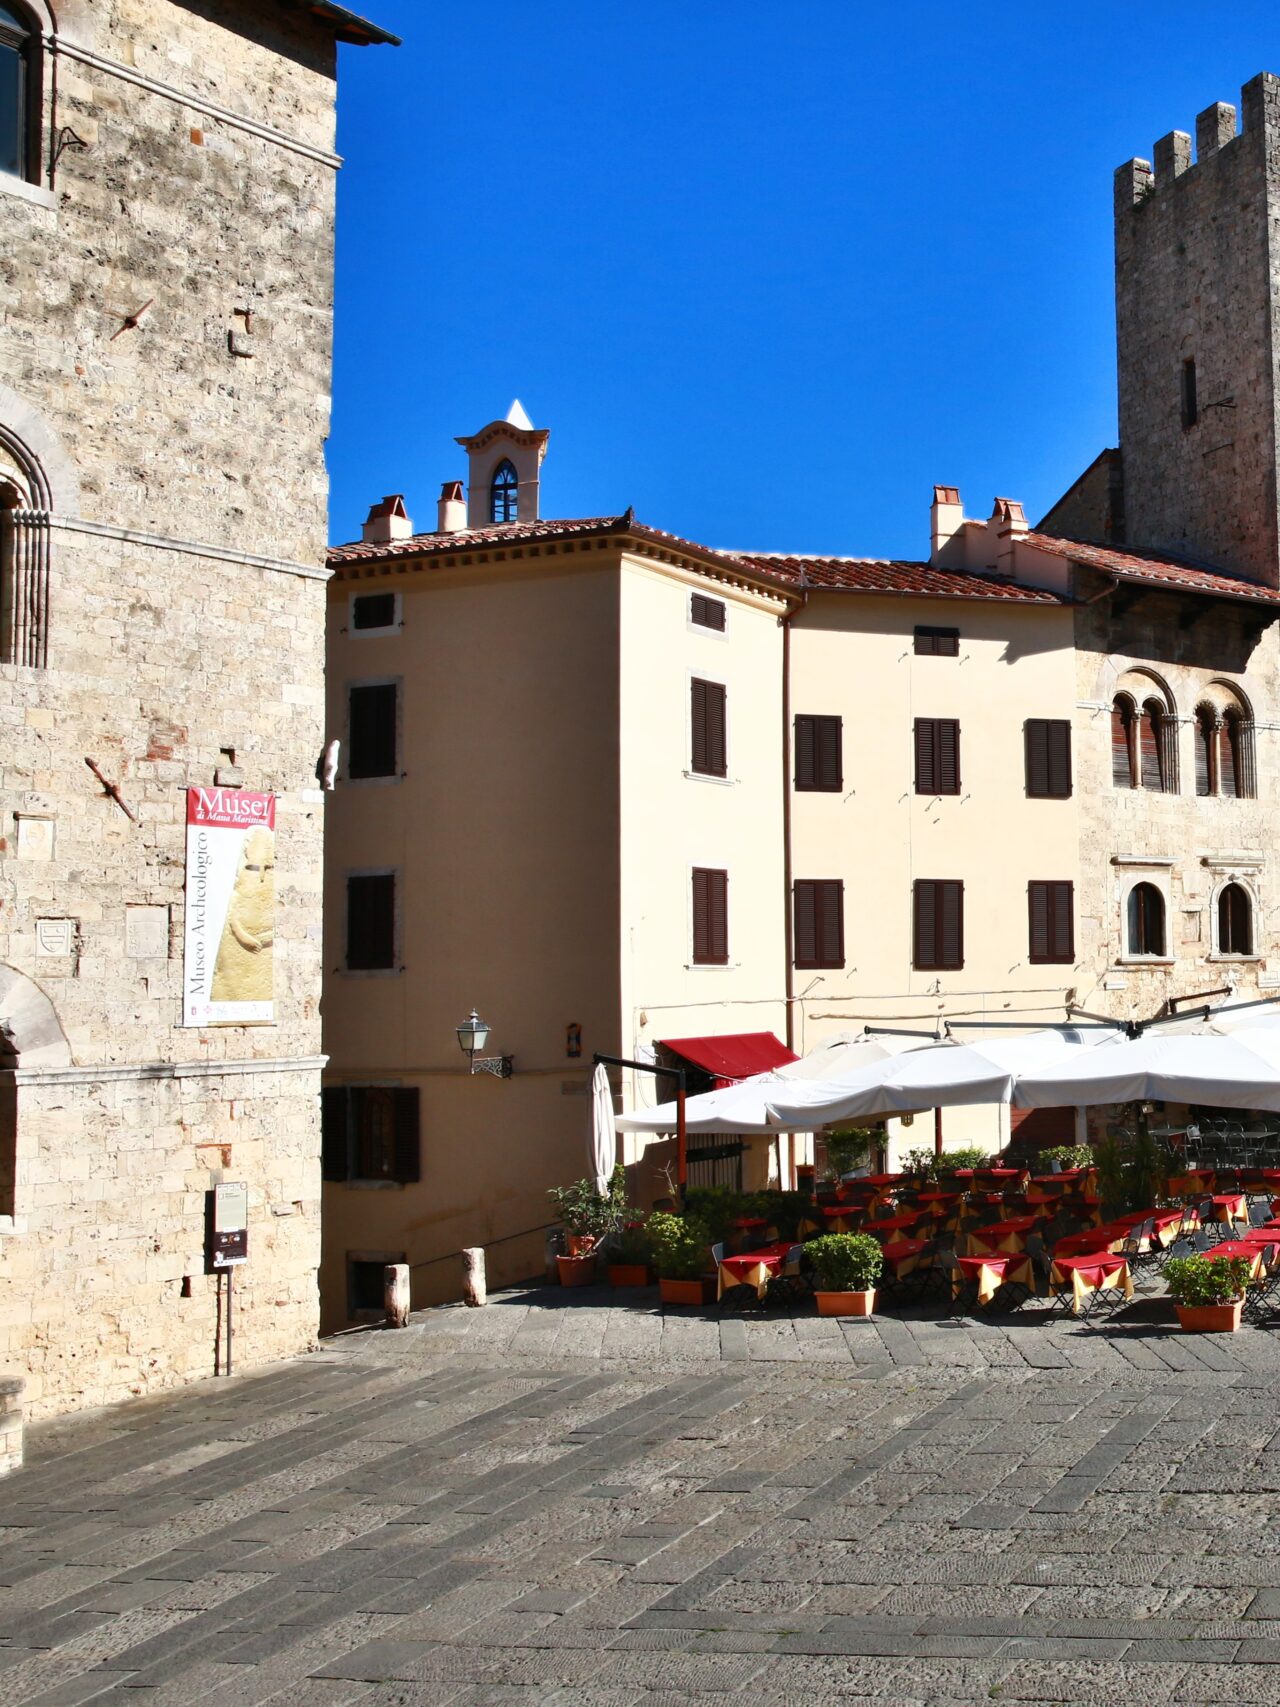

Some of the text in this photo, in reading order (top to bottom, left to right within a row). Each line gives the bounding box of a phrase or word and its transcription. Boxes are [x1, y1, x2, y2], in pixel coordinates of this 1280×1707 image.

[196, 788, 268, 816] Musei
[197, 812, 205, 820] di
[190, 832, 211, 995] Museo Archeologico
